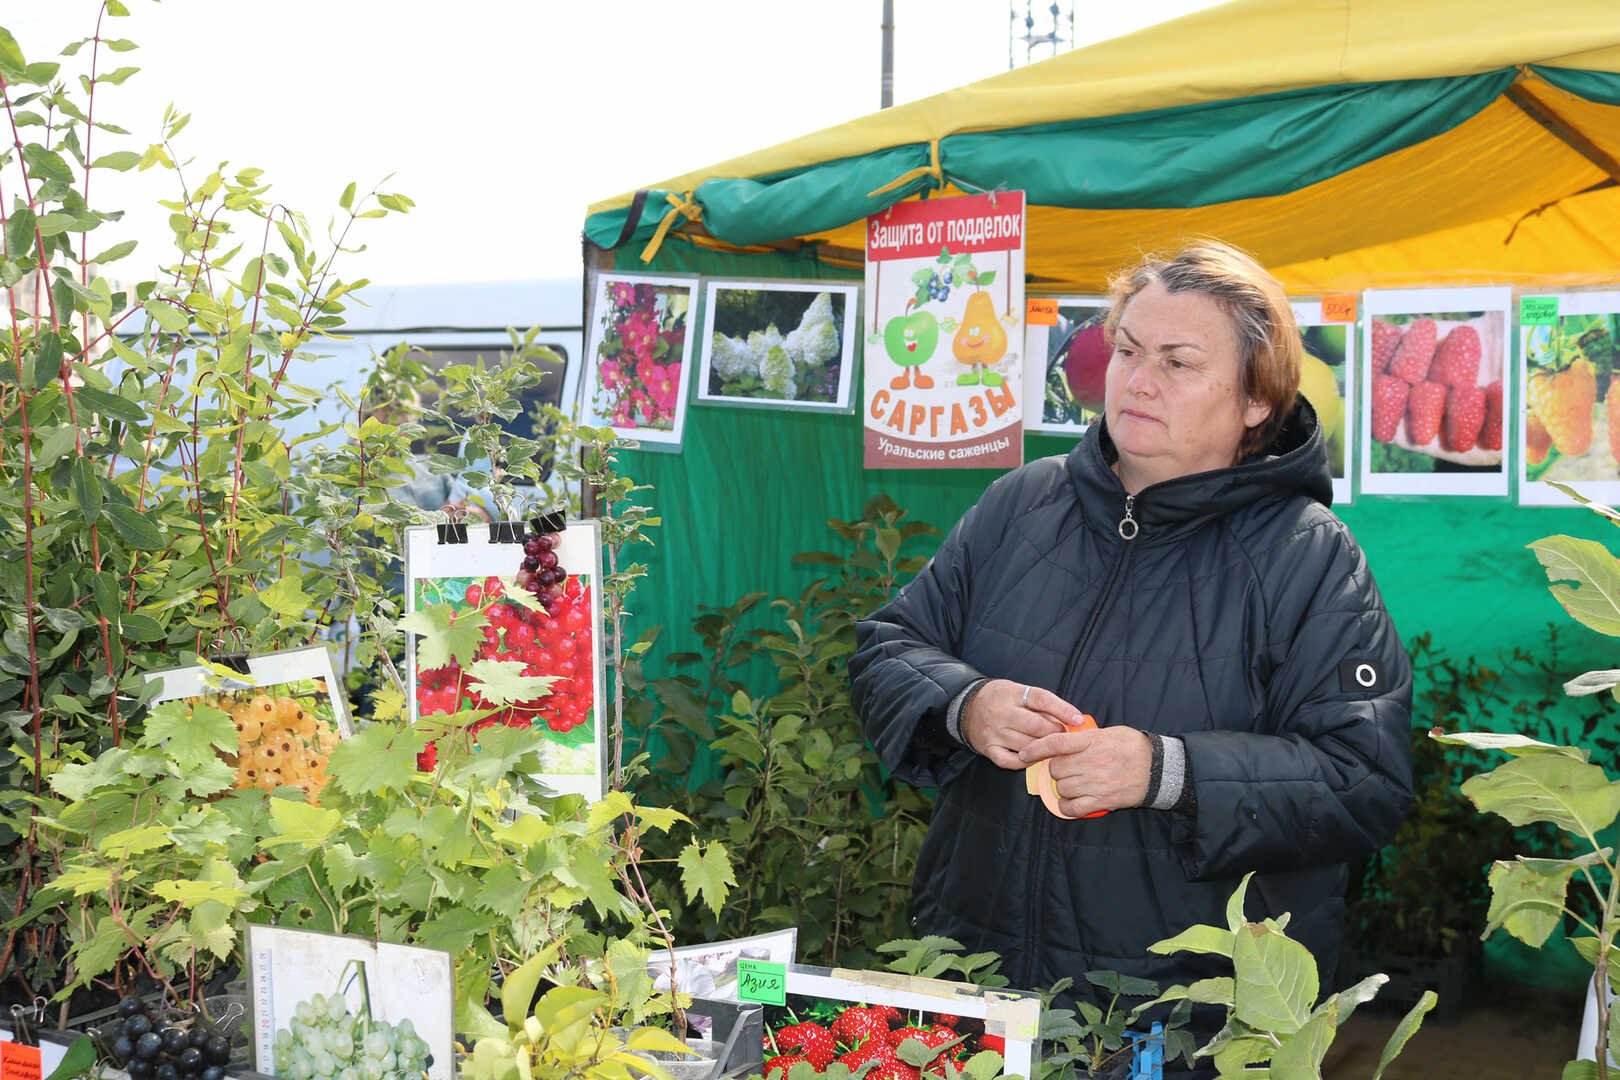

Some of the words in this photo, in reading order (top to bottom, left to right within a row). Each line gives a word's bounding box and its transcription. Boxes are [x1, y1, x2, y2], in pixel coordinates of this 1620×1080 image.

[871, 220, 924, 252] Защита
[926, 219, 945, 244] от
[947, 213, 1020, 246] подделок
[870, 379, 1016, 437] САРГАЗЫ
[878, 438, 946, 460] Уральские
[948, 437, 1010, 460] саженцы
[739, 962, 757, 970] ЦЕНА
[740, 973, 780, 993] Азия
